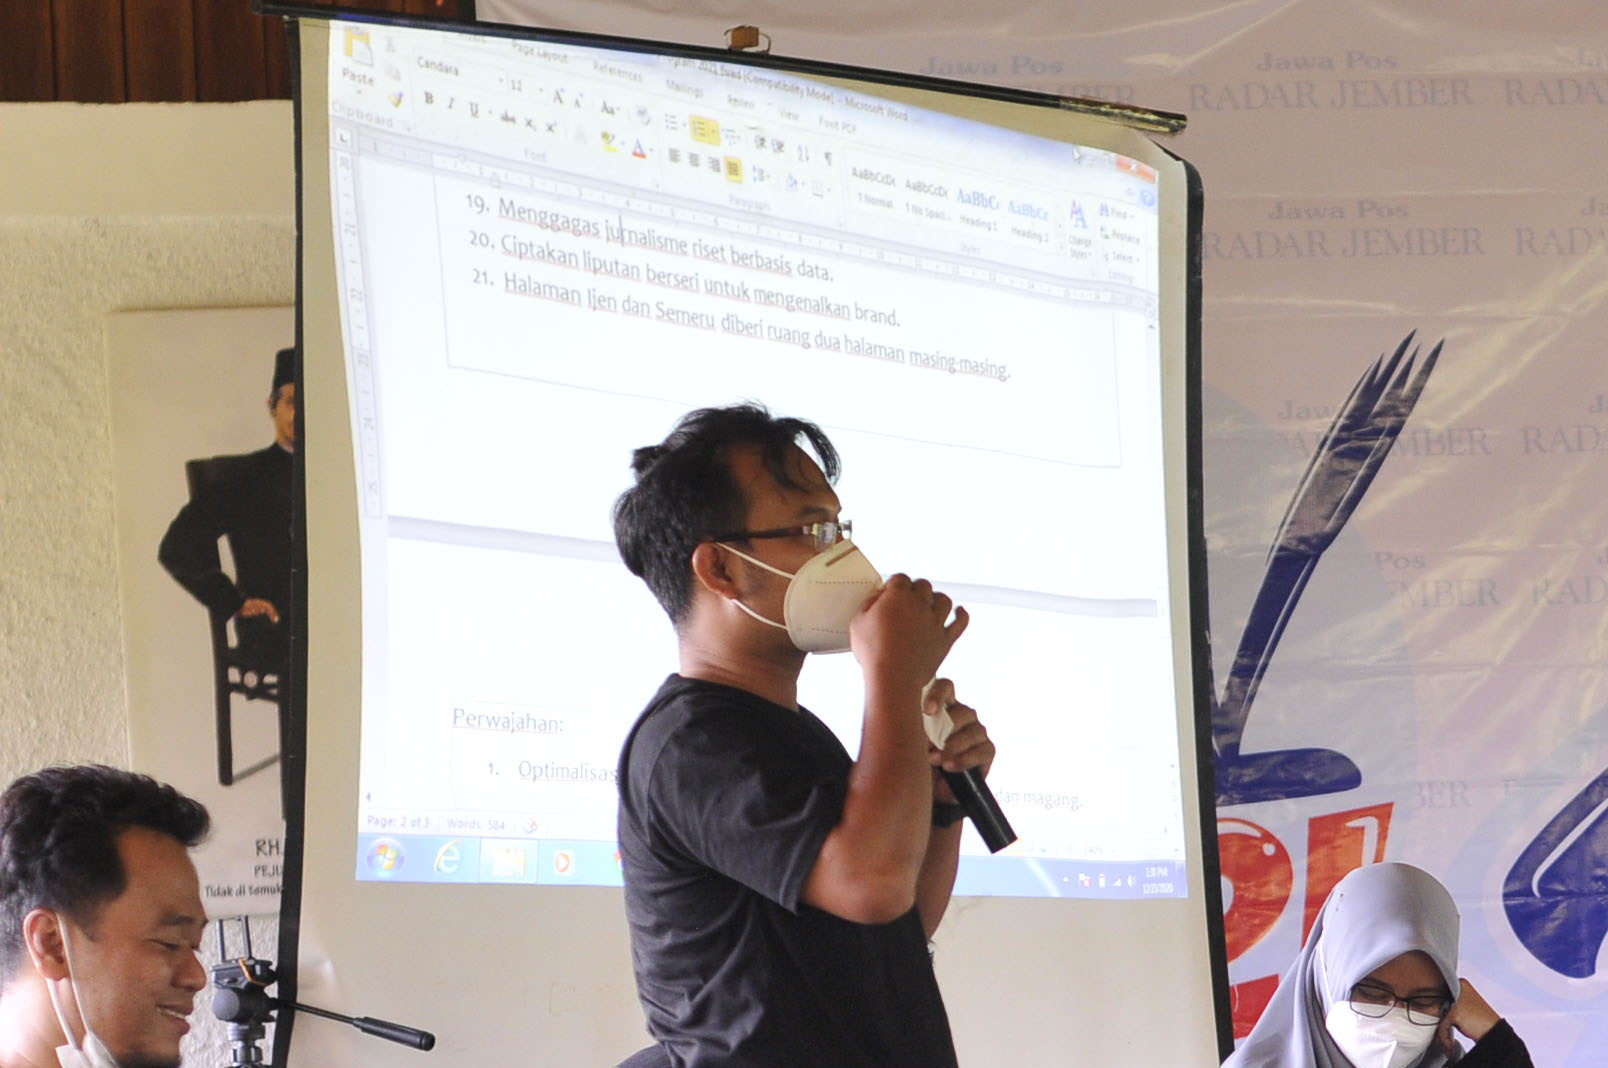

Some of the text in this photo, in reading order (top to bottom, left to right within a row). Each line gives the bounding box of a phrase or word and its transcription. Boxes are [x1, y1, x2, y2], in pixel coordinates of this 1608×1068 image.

[537, 47, 569, 64] Layout
[1345, 51, 1397, 70] Pos
[416, 55, 460, 77] Candara
[593, 60, 643, 83] References
[1010, 56, 1065, 76] Pos
[342, 67, 375, 87] Paste
[511, 79, 522, 92] 12
[665, 79, 704, 99] Mailings
[1187, 79, 1476, 113] RADAR JEMBER
[332, 102, 394, 128] Clipboard
[523, 147, 547, 163] Font
[1267, 201, 1410, 221] Jawa Pos
[467, 195, 834, 282] 19. Menggagas jurnalisme riset berbasis data.
[1204, 228, 1486, 261] RADAR JEMBER
[469, 231, 900, 327] 20. Ciptakan liputan berseri untuk mengenalkan brand.
[472, 269, 494, 285] 21.
[504, 272, 581, 304] Halaman
[621, 295, 650, 314] dan
[655, 302, 715, 328] Semeru
[721, 312, 764, 337] diberi
[767, 325, 811, 349] ruang
[814, 330, 840, 349] dua
[844, 333, 904, 361] halaman
[909, 350, 1010, 382] masing-masing.
[452, 708, 563, 733] Perwajahan:
[489, 760, 622, 784] 1. Optimalisas
[1023, 791, 1083, 811] magang.
[367, 815, 397, 828] Page:
[411, 816, 421, 828] of
[205, 884, 233, 897] Tidak
